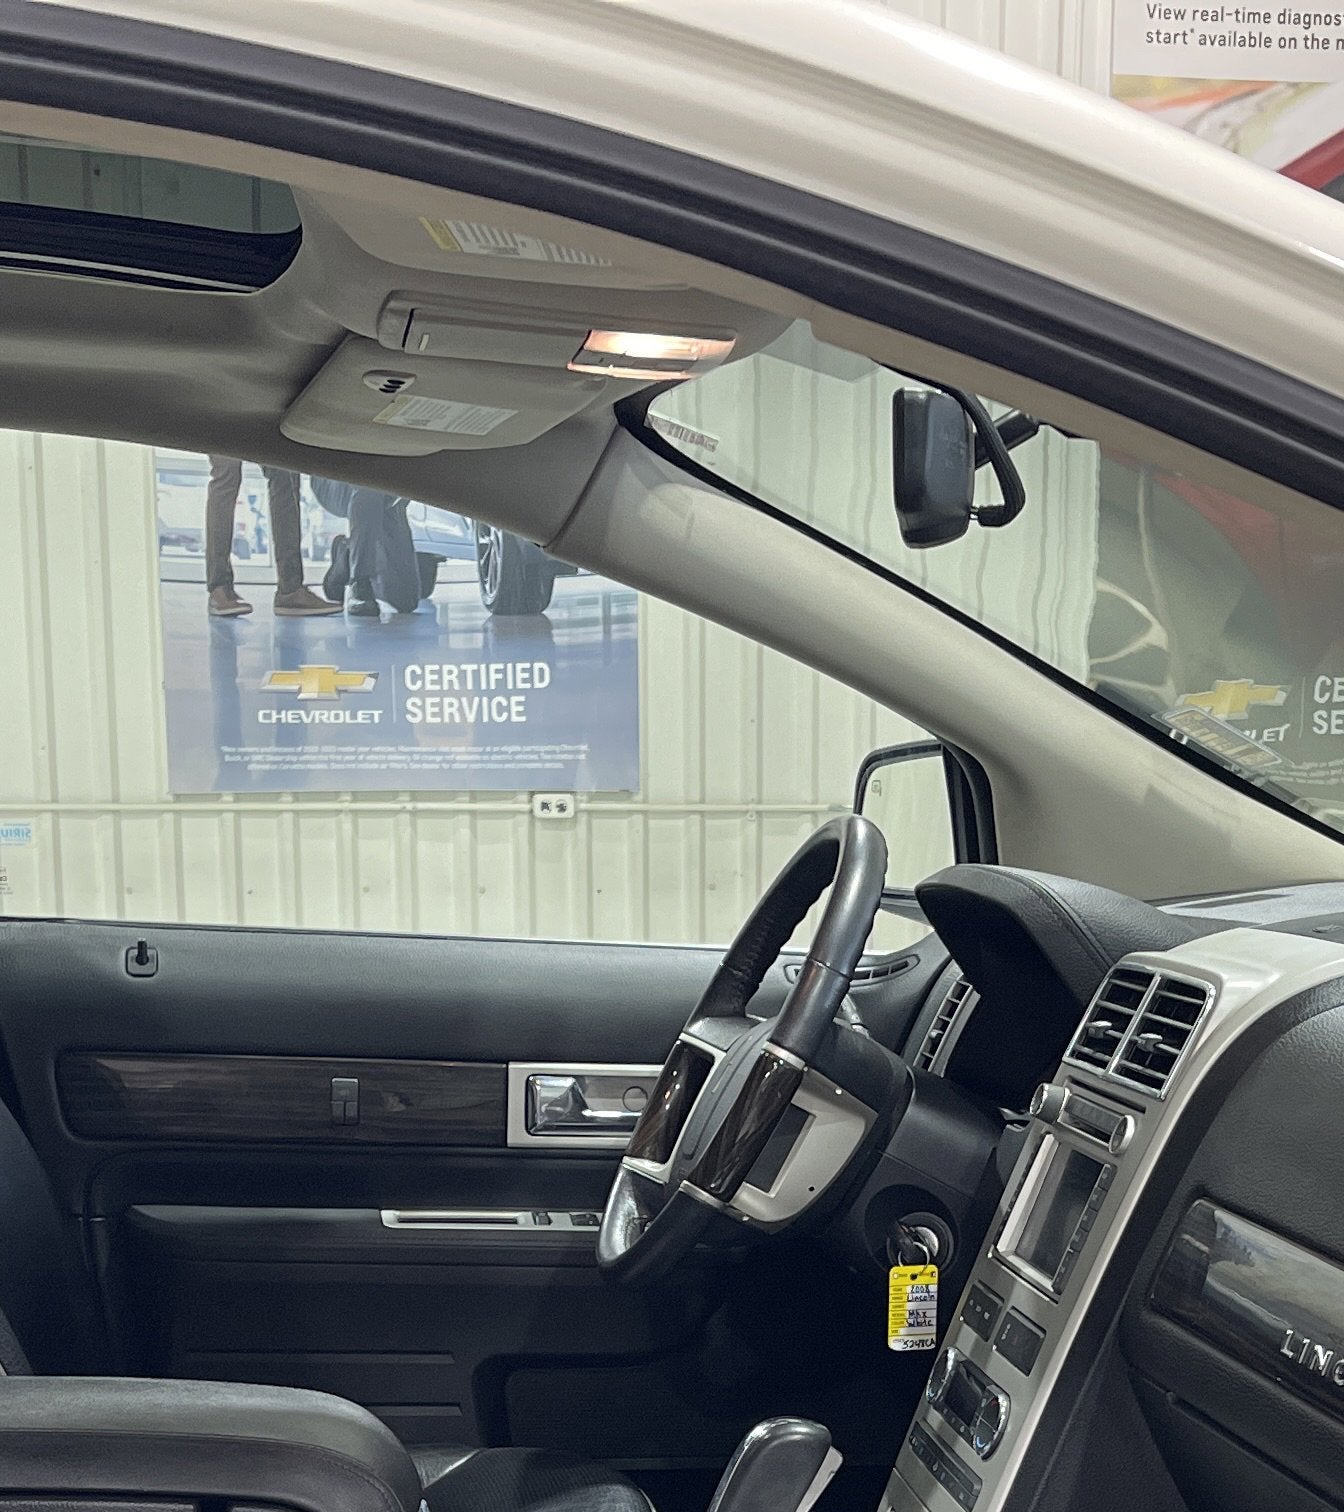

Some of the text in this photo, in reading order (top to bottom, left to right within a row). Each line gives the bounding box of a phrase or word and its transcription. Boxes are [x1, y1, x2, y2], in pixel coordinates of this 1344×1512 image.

[1146, 3, 1187, 22] View
[1192, 5, 1272, 24] real-time
[1198, 30, 1273, 49] available
[1278, 35, 1298, 50] on
[1303, 33, 1330, 50] the
[404, 662, 552, 691] CERTIFIED
[257, 709, 384, 725] CHEVROLET
[405, 696, 528, 724] SERVICE
